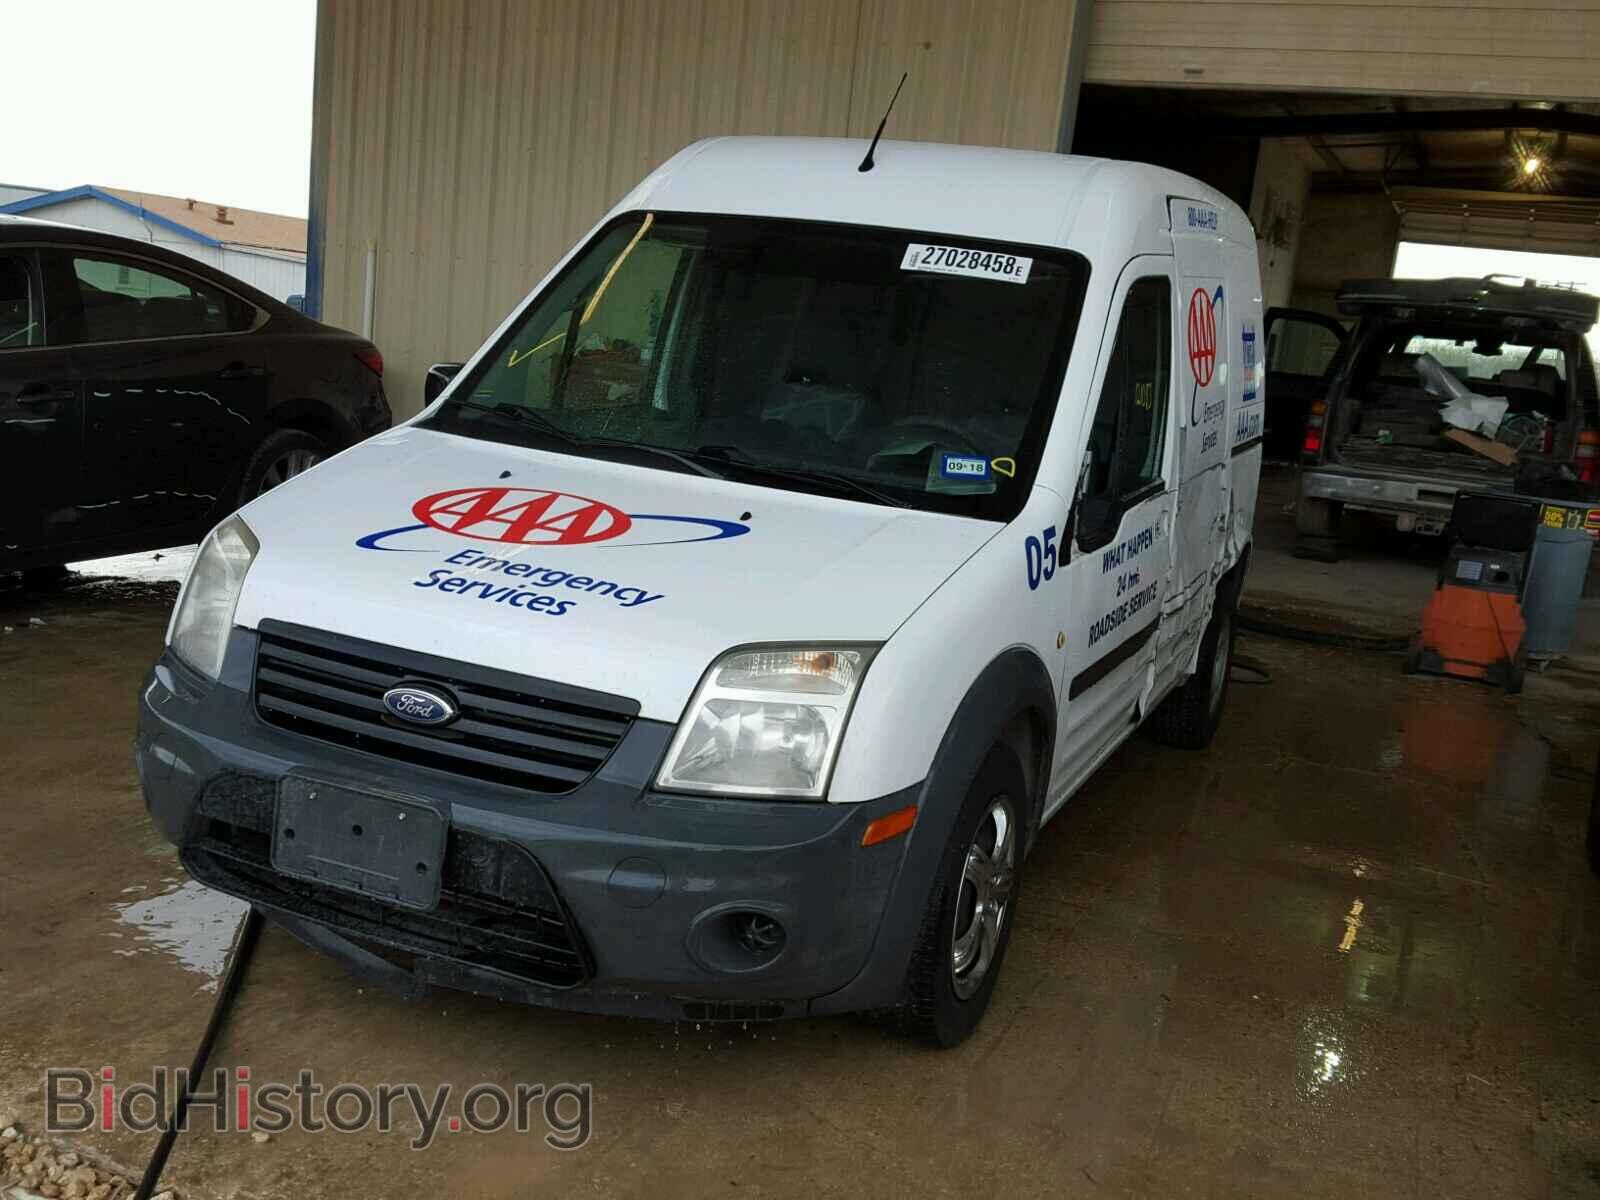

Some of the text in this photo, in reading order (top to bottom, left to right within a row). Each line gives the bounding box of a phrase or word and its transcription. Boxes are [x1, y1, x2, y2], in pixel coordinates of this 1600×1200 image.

[424, 487, 618, 545] AAA
[443, 549, 665, 609] Emergency
[1102, 542, 1127, 574] WHAT
[413, 569, 578, 617] Services
[1117, 572, 1127, 597] 24
[1088, 580, 1158, 648] ROADSIDE SERVICE
[396, 694, 435, 718] Ford
